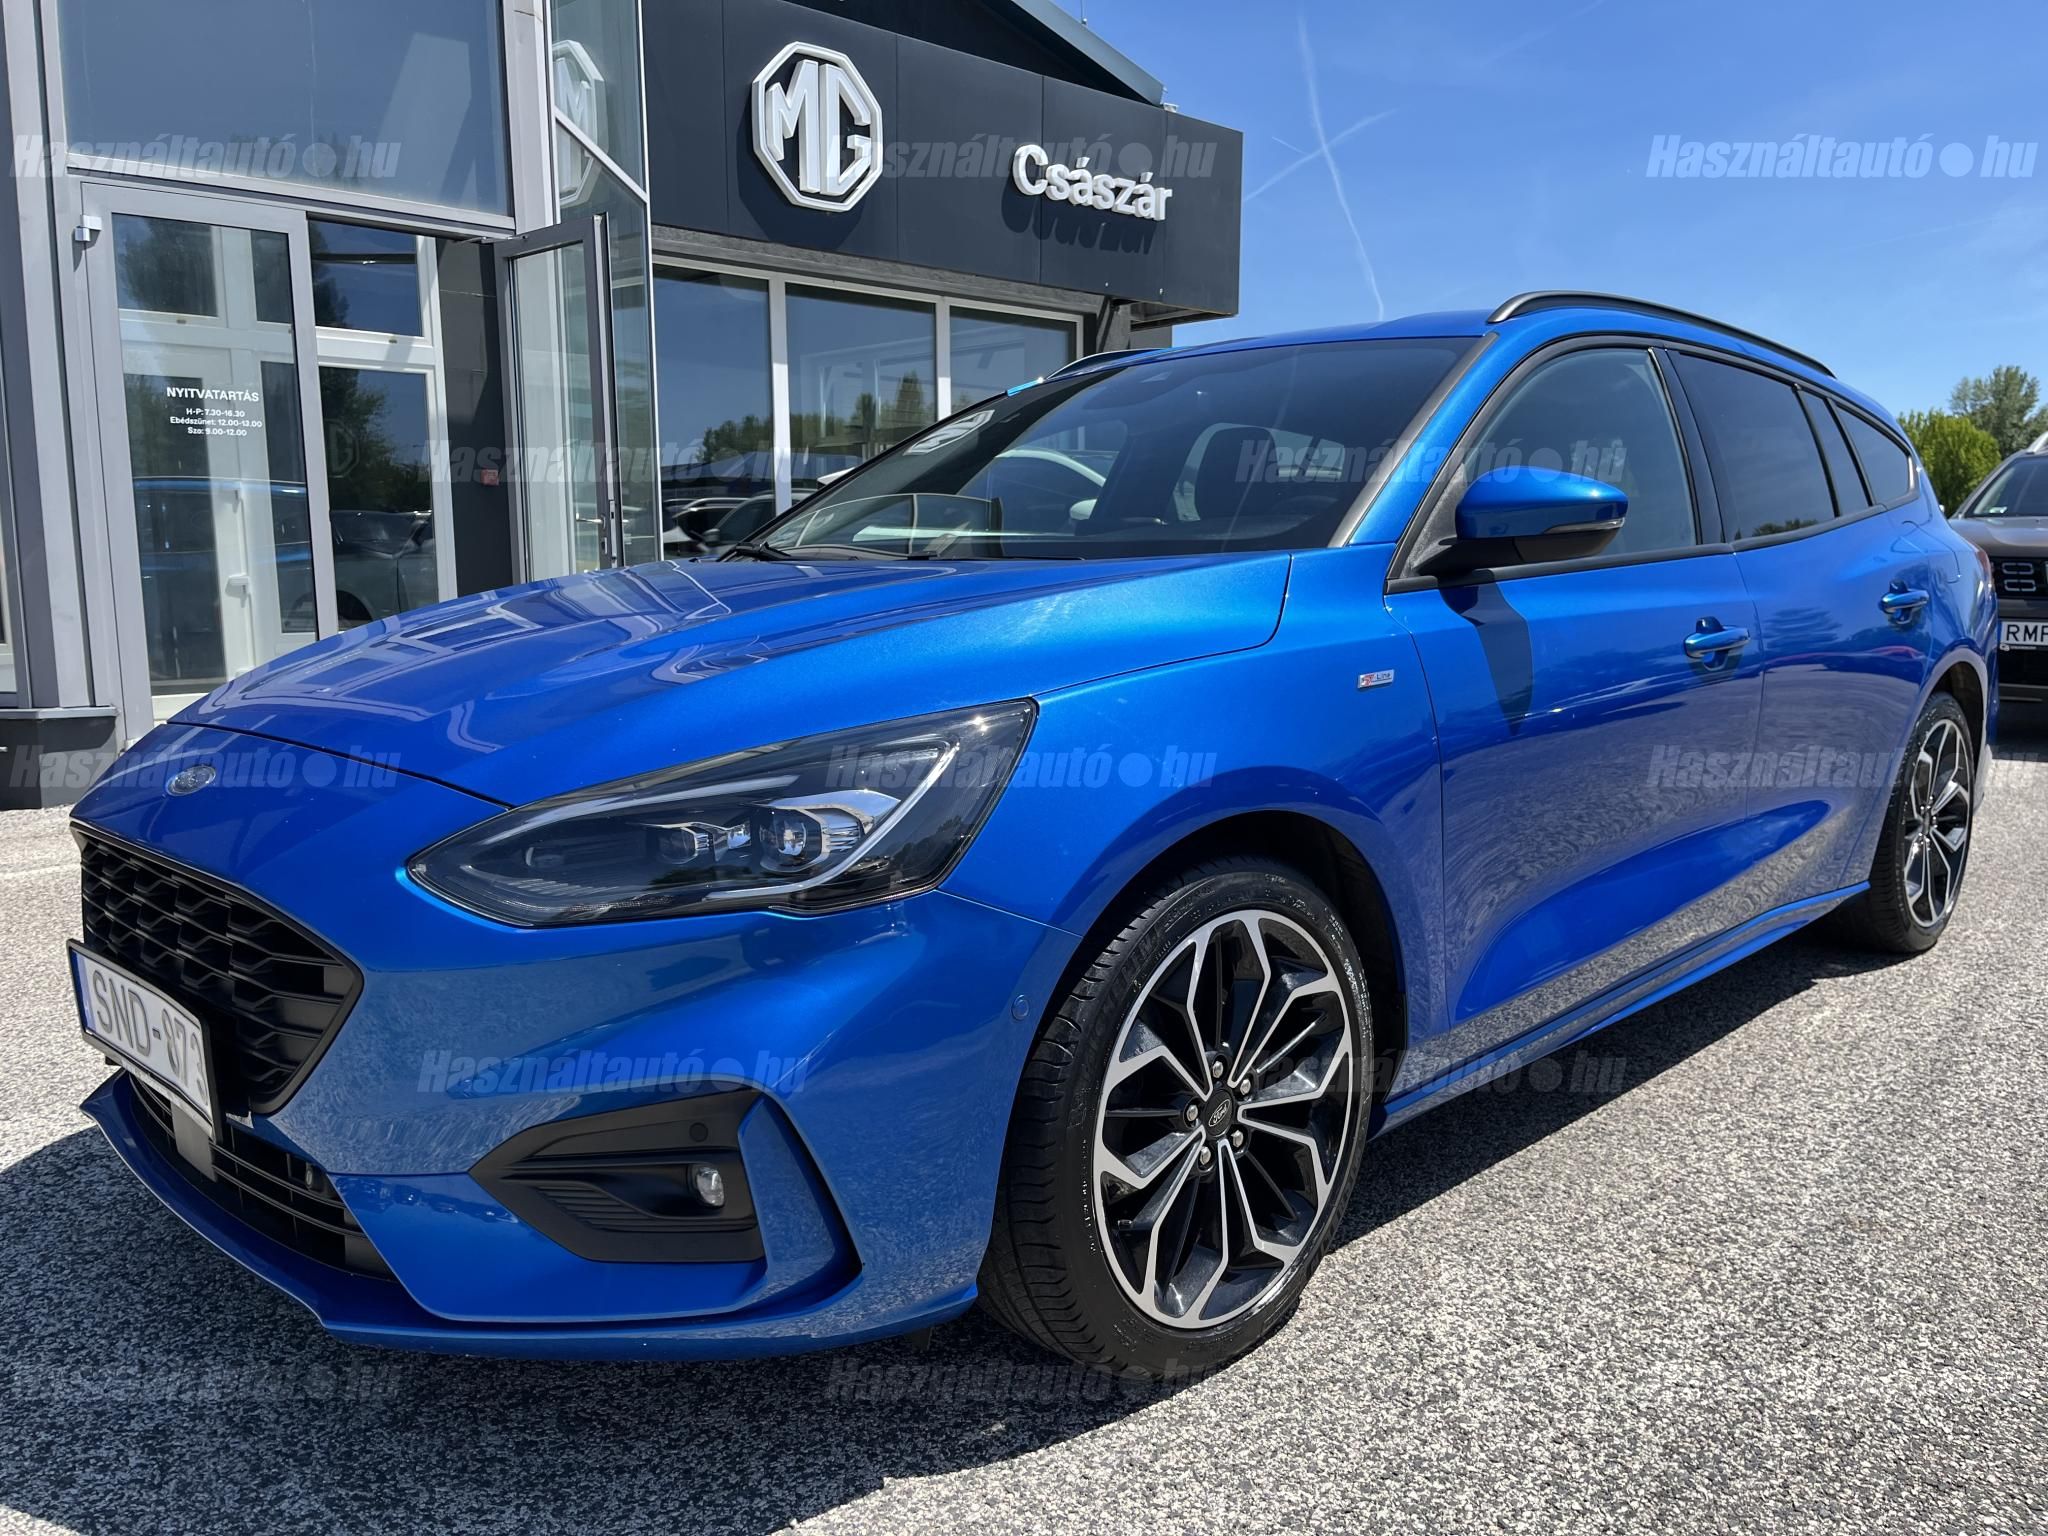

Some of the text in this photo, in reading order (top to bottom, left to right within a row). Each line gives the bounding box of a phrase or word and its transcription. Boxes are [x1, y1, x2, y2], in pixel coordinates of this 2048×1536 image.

[765, 58, 872, 196] MG
[1012, 144, 1173, 221] Császár
[166, 386, 259, 402] NYITVATARTÁS
